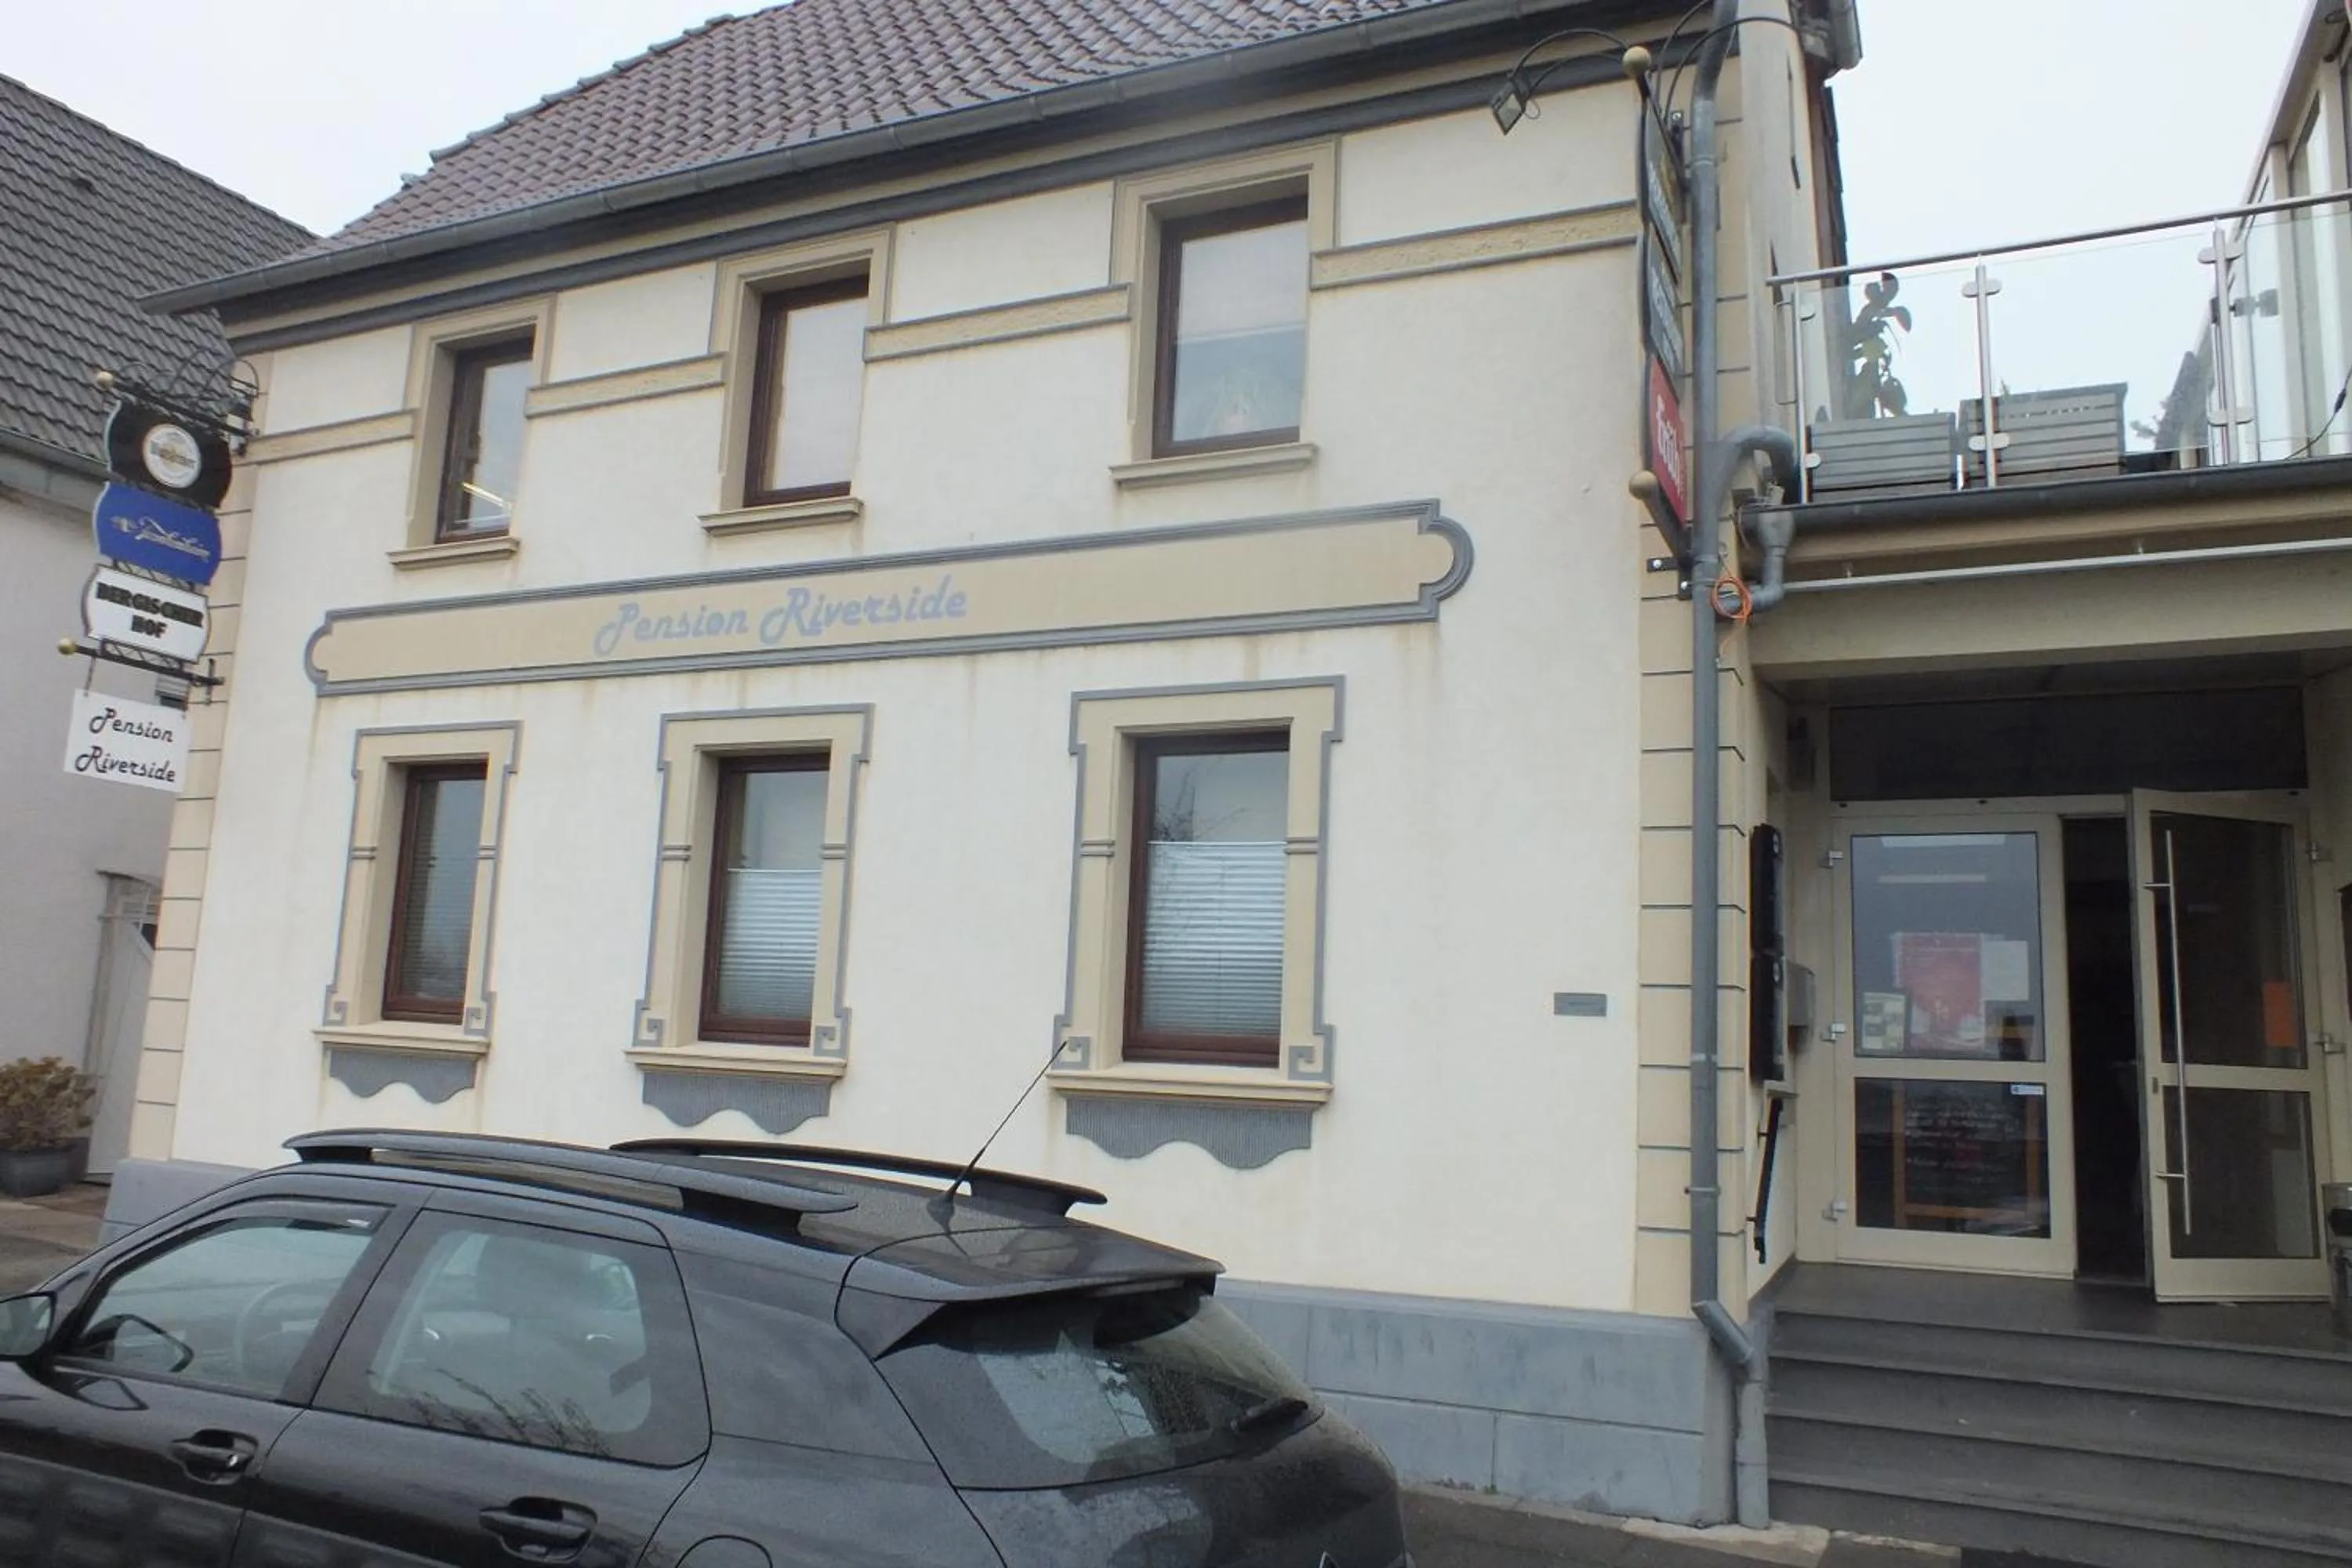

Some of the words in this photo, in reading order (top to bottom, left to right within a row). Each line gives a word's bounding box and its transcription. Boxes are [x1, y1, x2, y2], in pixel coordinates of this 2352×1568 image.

[593, 601, 750, 658] Pension
[759, 572, 968, 646] Riverside
[89, 706, 175, 743] Pension
[74, 745, 176, 783] Riverside
